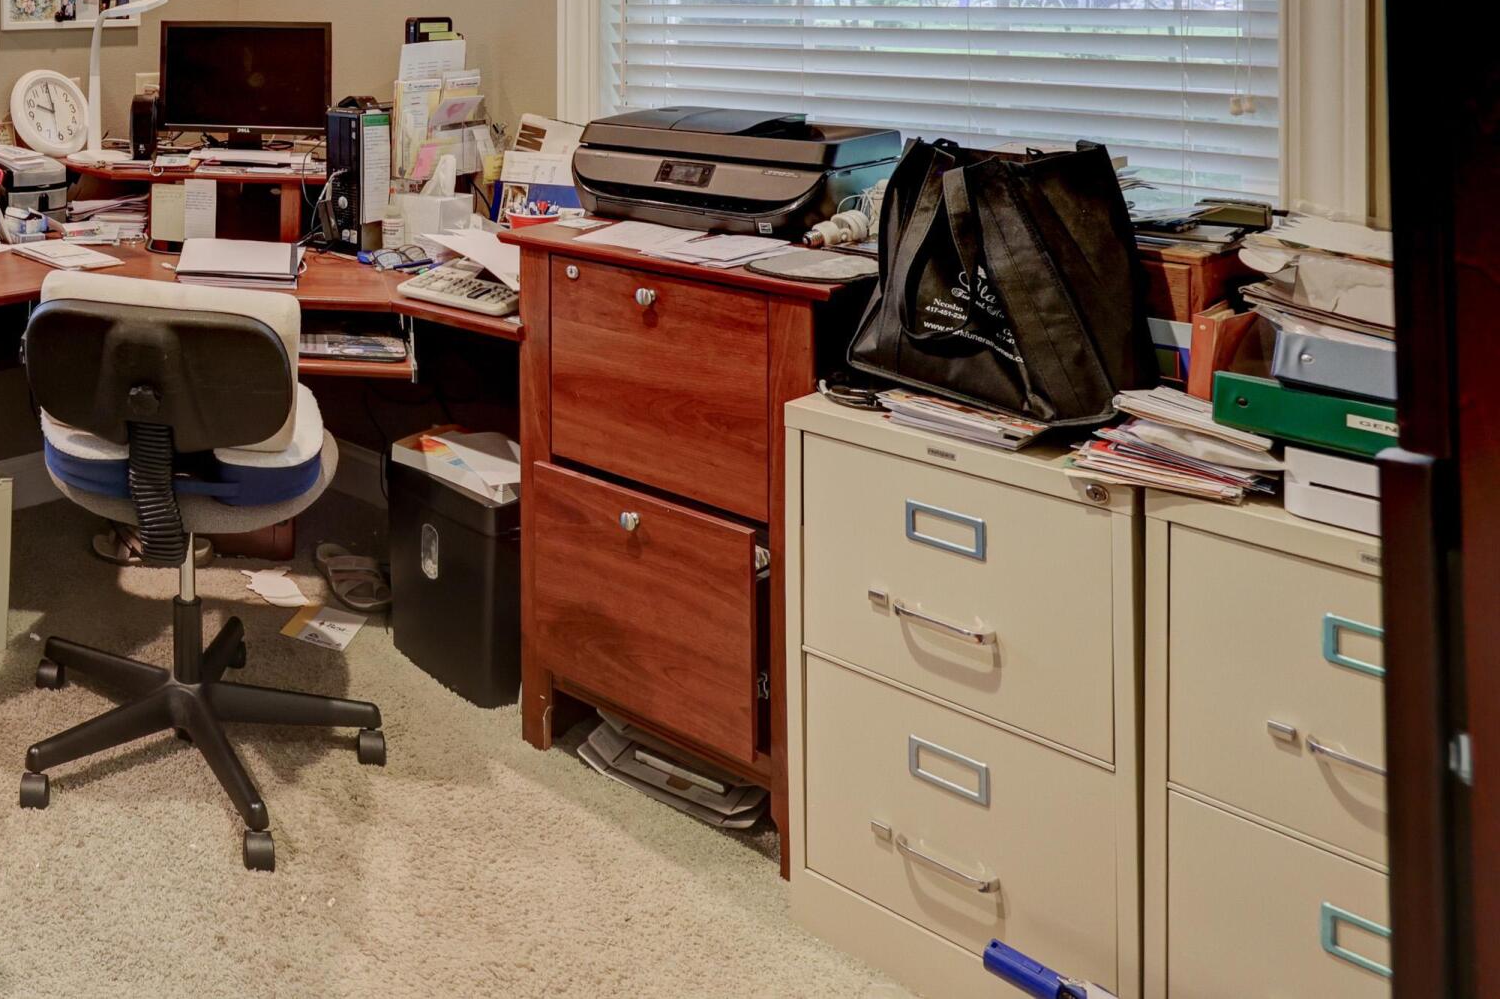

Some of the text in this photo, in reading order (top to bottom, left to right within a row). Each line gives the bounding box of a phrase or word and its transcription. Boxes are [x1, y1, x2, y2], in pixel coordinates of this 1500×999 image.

[62, 92, 70, 103] 2
[26, 99, 36, 109] 10
[68, 104, 76, 114] 3
[28, 111, 35, 121] 9
[36, 122, 43, 132] 8
[58, 131, 64, 141] 6
[933, 298, 964, 312] Neosho
